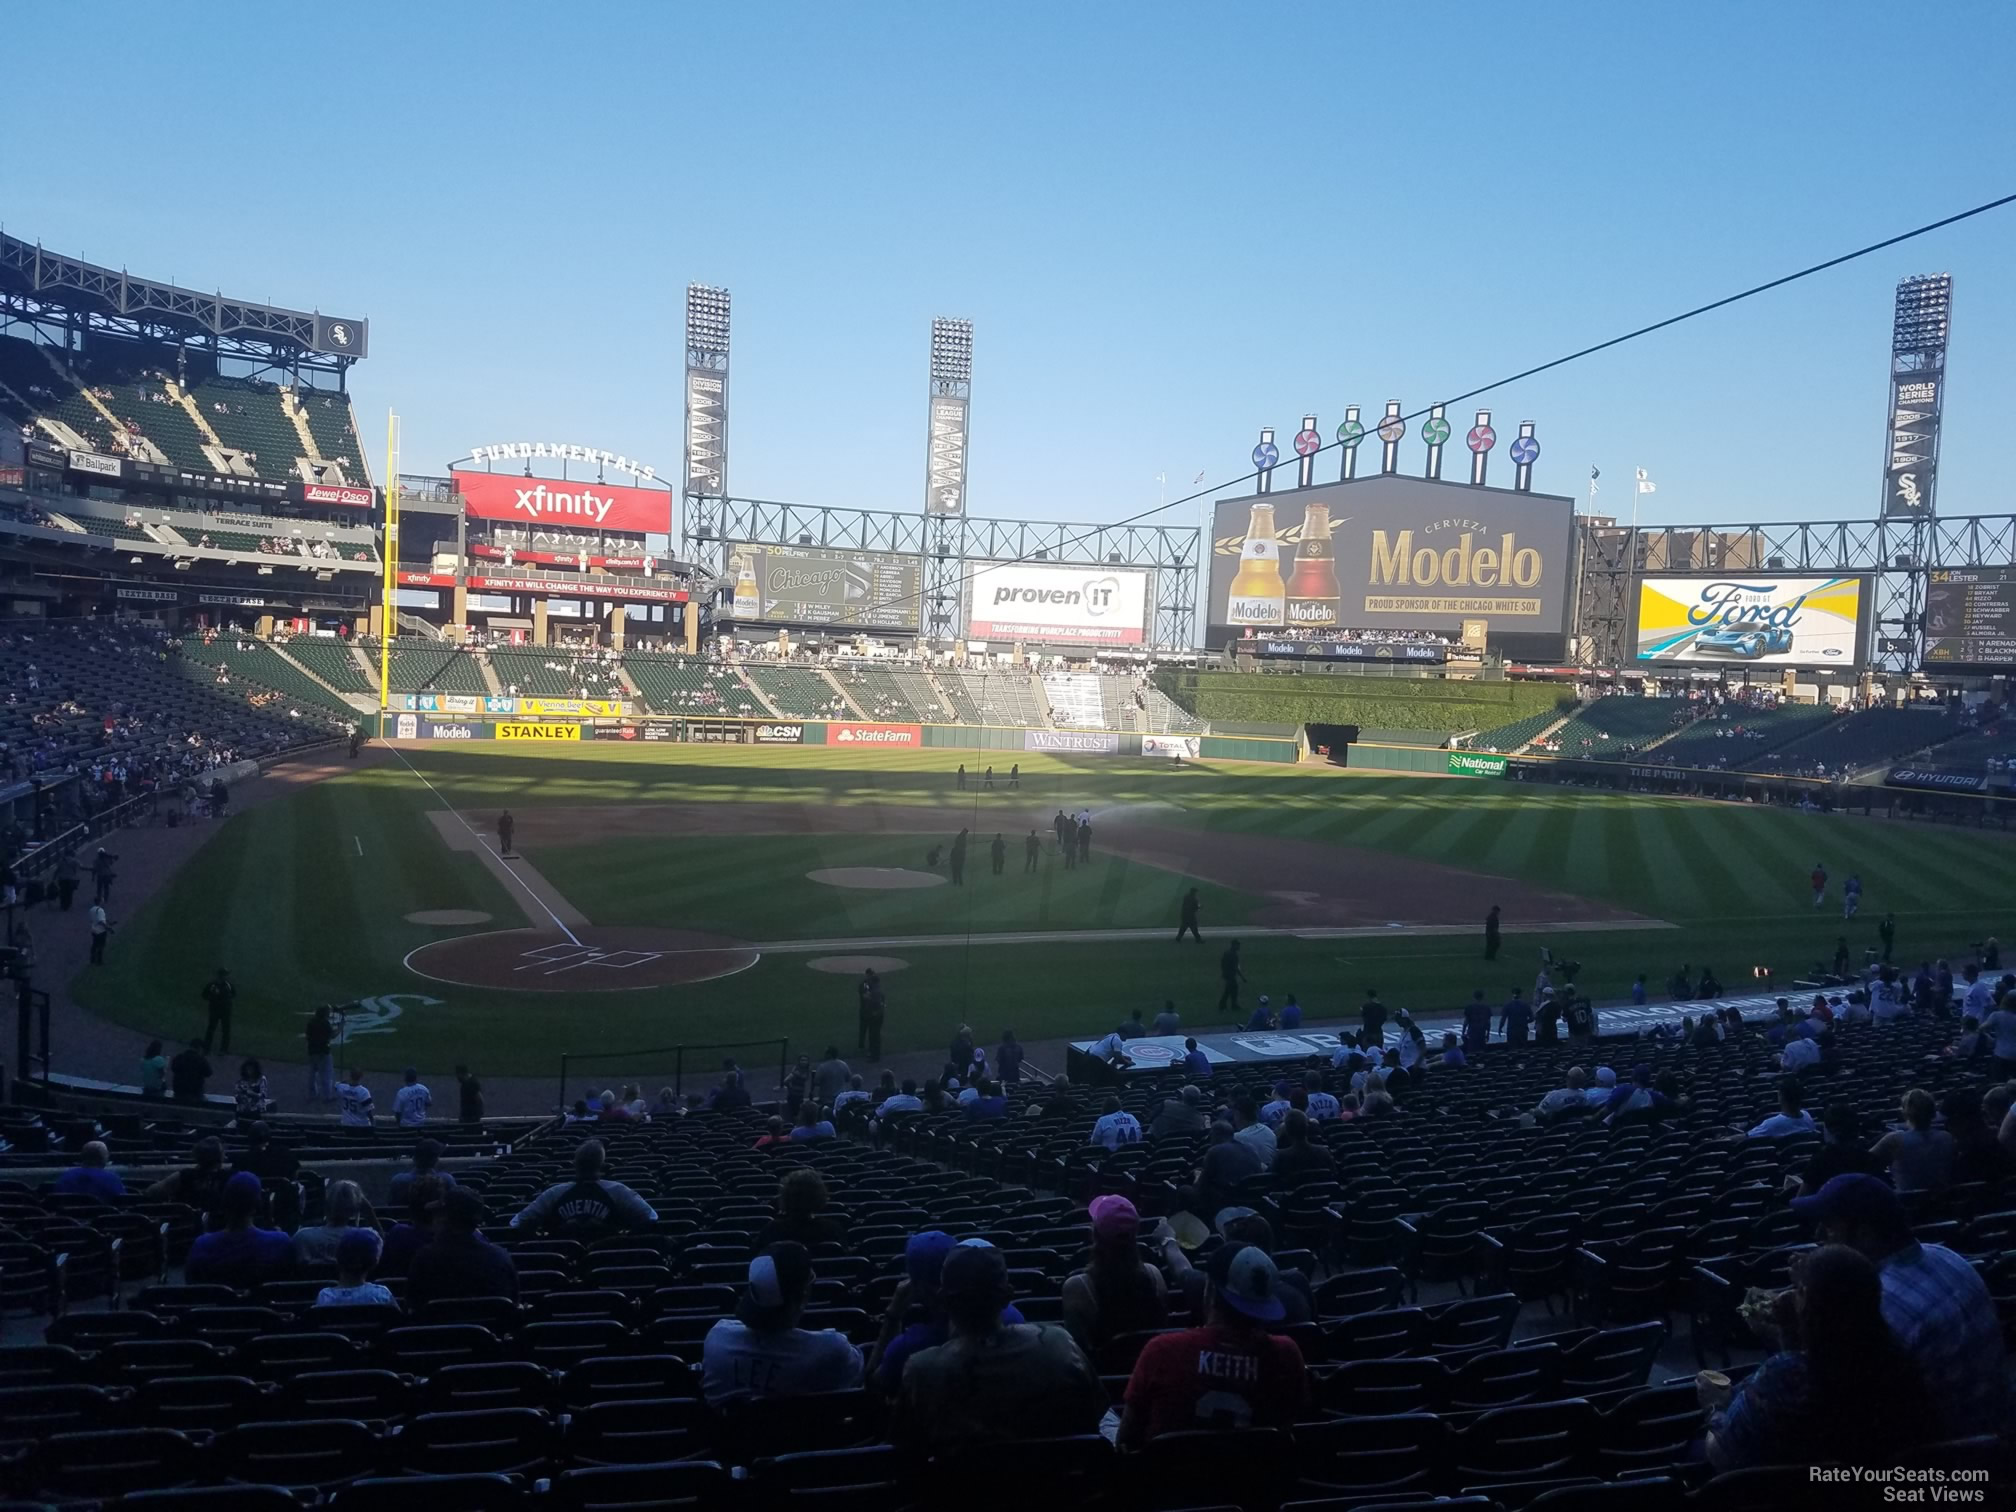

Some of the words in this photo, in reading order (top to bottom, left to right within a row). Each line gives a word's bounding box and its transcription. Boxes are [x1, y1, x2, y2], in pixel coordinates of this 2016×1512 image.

[1898, 383, 1935, 392] WORLD
[1898, 390, 1934, 400] SERIES
[85, 458, 117, 472] Ballpark
[471, 442, 655, 481] FUNDAMENTALS
[308, 487, 369, 502] Jewel-Osco
[515, 485, 614, 522] xfinity
[215, 518, 251, 527] TERRACE
[252, 521, 273, 529] SUITE
[1425, 518, 1487, 535] CERVEZA
[767, 546, 782, 555] 50
[1368, 530, 1542, 588] Modelo
[407, 575, 431, 584] xfinity
[768, 567, 844, 596] Chicago
[1931, 571, 1949, 582] 34
[125, 591, 152, 599] EXTRA
[155, 592, 176, 600] BASE
[484, 579, 513, 588] XFINITY
[525, 581, 545, 590] WILL
[546, 582, 578, 592] CHANGE
[579, 584, 594, 593] THE
[596, 585, 612, 594] WAY
[613, 586, 628, 595] YOU
[629, 587, 667, 598] EXPERIENCE
[669, 591, 677, 599] TV
[240, 597, 262, 605] BASE
[993, 586, 1081, 606] proven
[1092, 588, 1112, 606] IT
[1235, 602, 1277, 618] Modelo
[1290, 603, 1332, 620] Modelo
[1369, 599, 1393, 609] PROUD
[1396, 599, 1429, 610] SPONSOR
[1432, 600, 1442, 610] OF
[1443, 600, 1457, 610] THE
[1460, 600, 1493, 611] CHICAGO
[1495, 601, 1519, 611] WHITE
[1521, 601, 1536, 611] SOX
[1688, 582, 1808, 628] Ford
[991, 624, 1039, 635] TRANSFORMING
[1039, 627, 1077, 636] WORKPLACE
[1077, 628, 1123, 638] PRODUCTIVITY
[1267, 643, 1294, 654] Modelo
[1336, 645, 1362, 656] Modelo
[1406, 647, 1435, 658] Modelo
[448, 696, 464, 705] Bring
[567, 701, 584, 709] Beef
[434, 726, 471, 738] Modelo
[502, 726, 574, 738] STANLEY
[773, 726, 802, 737] CSN
[1460, 757, 1504, 770] National
[1631, 768, 1651, 777] THE
[1916, 772, 1979, 787] HYUNDAI
[343, 1098, 357, 1112] 35
[1116, 1127, 1136, 1143] 44
[558, 1200, 609, 1219] QUENTIN
[1198, 1350, 1259, 1382] KEITH
[735, 1359, 780, 1392] LEE
